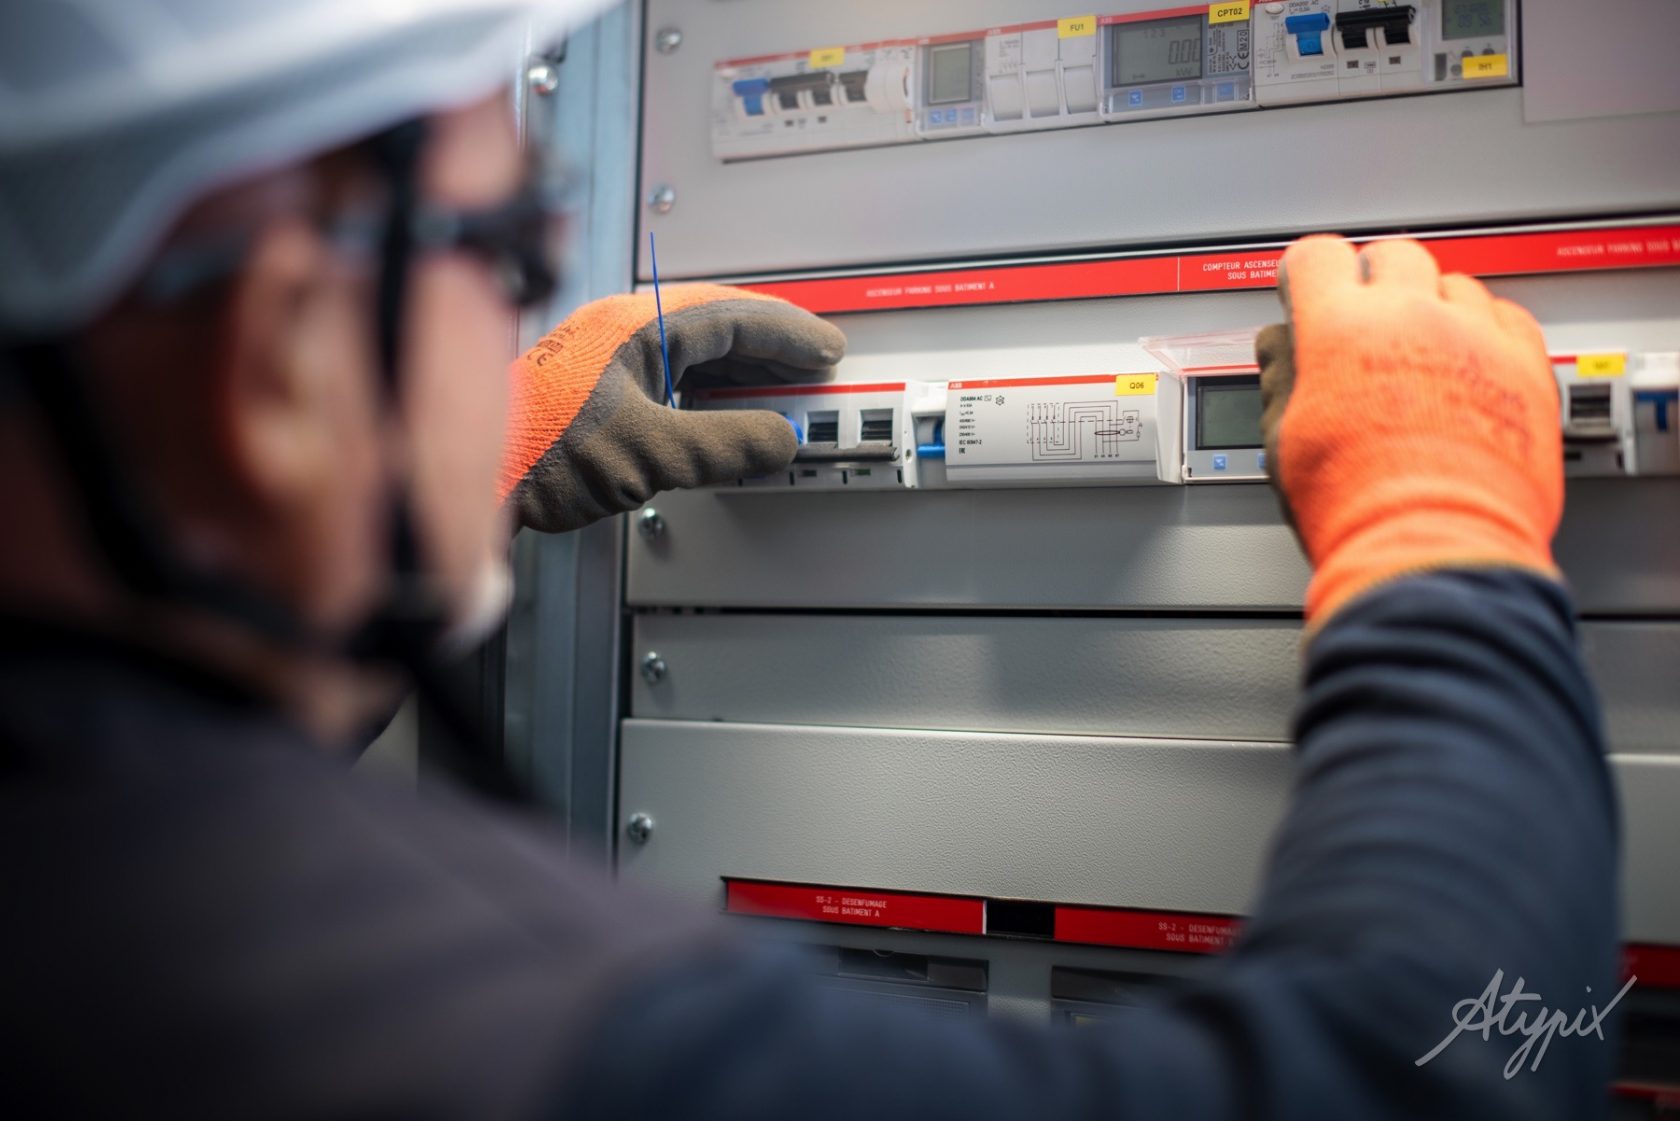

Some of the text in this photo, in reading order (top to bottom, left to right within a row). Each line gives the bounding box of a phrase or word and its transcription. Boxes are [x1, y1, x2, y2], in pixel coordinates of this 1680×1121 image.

[1217, 7, 1243, 18] CPT02
[1069, 23, 1085, 32] FU1
[1203, 259, 1282, 271] COMPTEUR ASCENSEU
[1227, 269, 1278, 280] SOUS BATIME
[1129, 382, 1144, 390] Q06
[841, 907, 872, 917] BATIMENT
